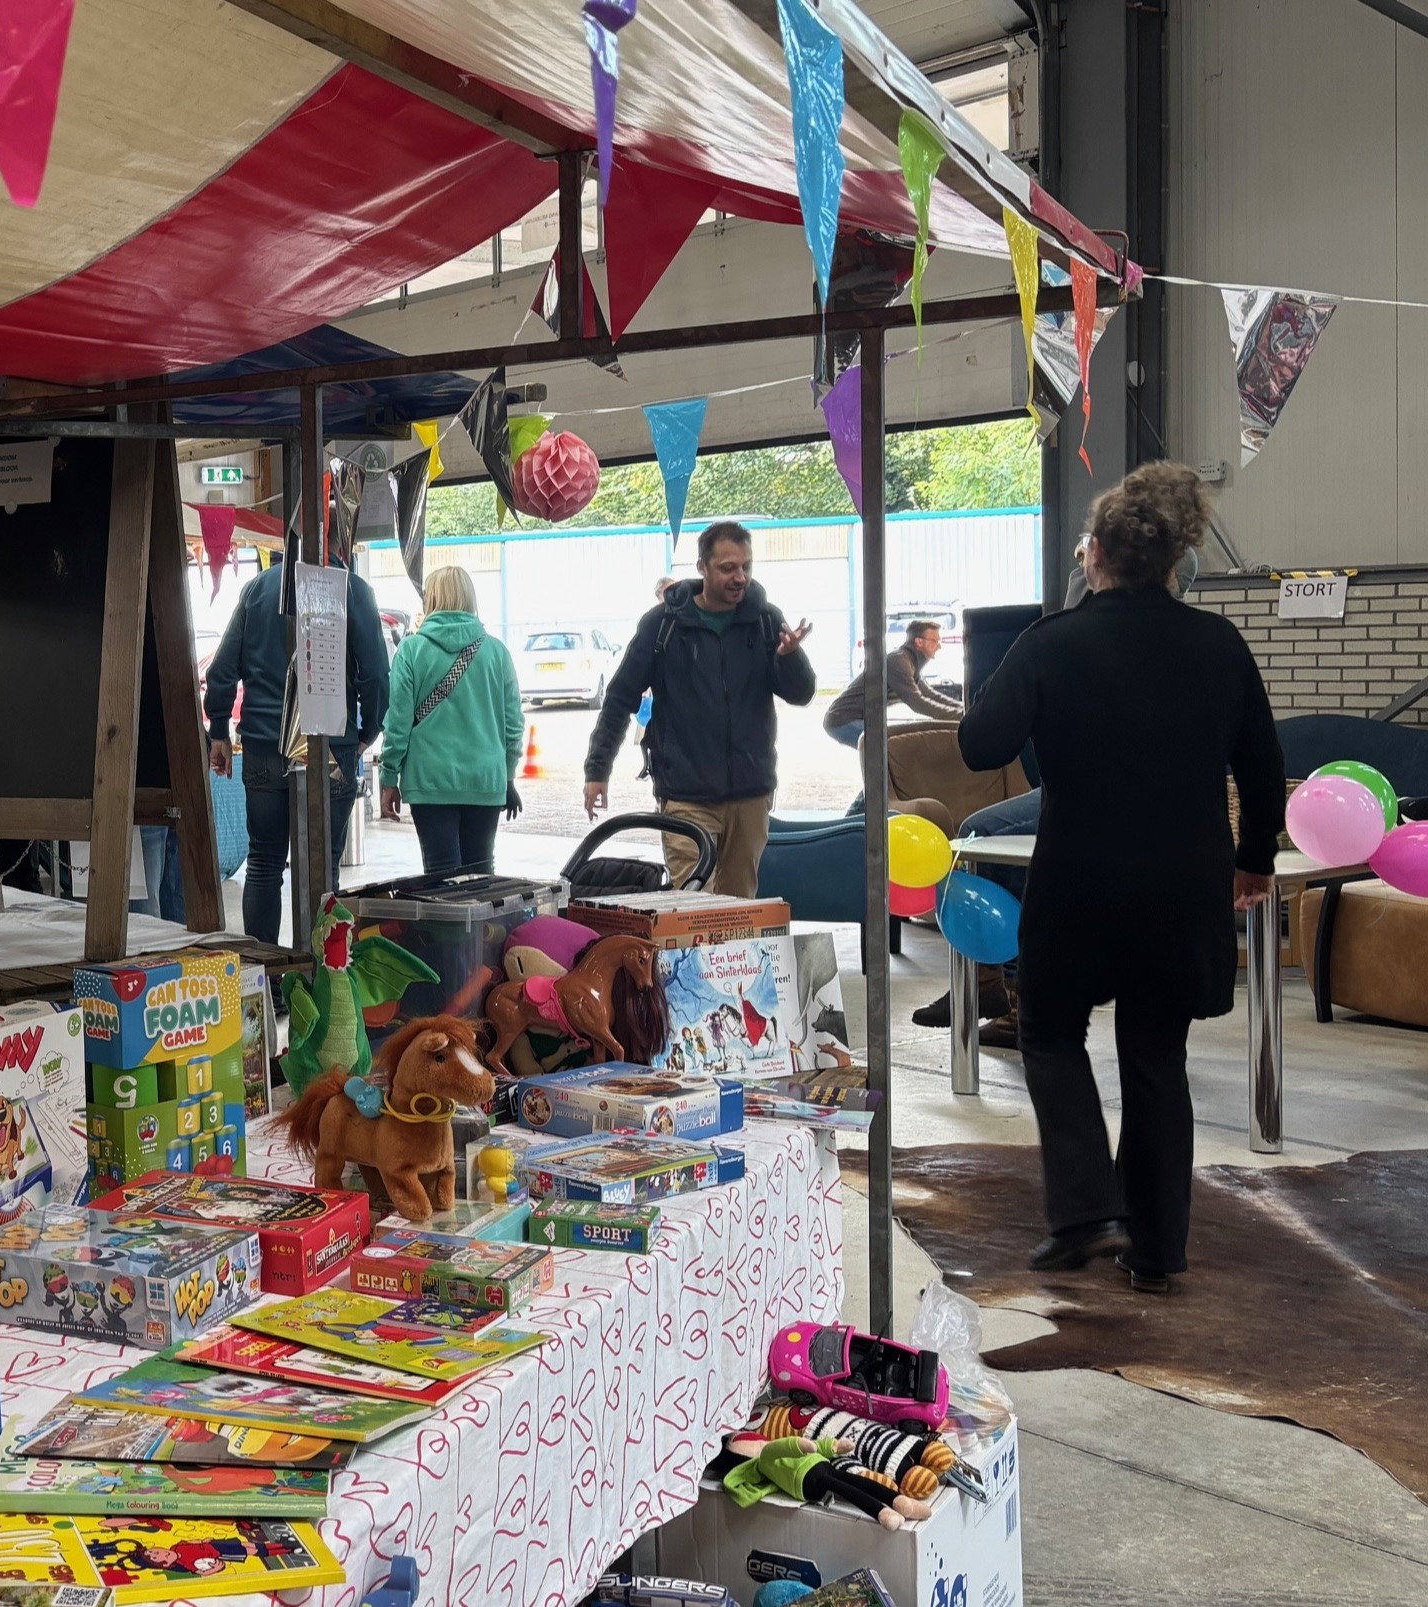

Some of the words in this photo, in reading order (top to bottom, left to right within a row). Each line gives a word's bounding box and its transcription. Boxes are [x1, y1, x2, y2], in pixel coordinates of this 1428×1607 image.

[1284, 582, 1337, 597] STORT
[708, 952, 725, 965] Een
[727, 950, 747, 963] brief
[699, 969, 714, 979] aan
[715, 962, 762, 979] Sinterklaas
[147, 986, 177, 1008] CAN
[178, 976, 219, 1002] TOSS
[100, 1000, 119, 1016] TOSS
[145, 997, 220, 1037] FOAM
[87, 1028, 111, 1040] GAME
[163, 1025, 207, 1049] GAME
[195, 1069, 204, 1087] 1
[554, 1090, 570, 1102] 240
[675, 1099, 688, 1111] 240
[184, 1111, 194, 1129] 2
[208, 1105, 219, 1124] 3
[172, 1152, 183, 1170] 4
[198, 1145, 208, 1161] 5
[222, 1139, 232, 1156] 6
[582, 1225, 632, 1241] SPORT
[174, 1268, 201, 1319] HOT
[187, 1279, 215, 1329] POP
[106, 1500, 125, 1510] Mega
[126, 1501, 160, 1510] Colouring
[161, 1501, 179, 1510] Book
[597, 1574, 726, 1599] SLINGERS
